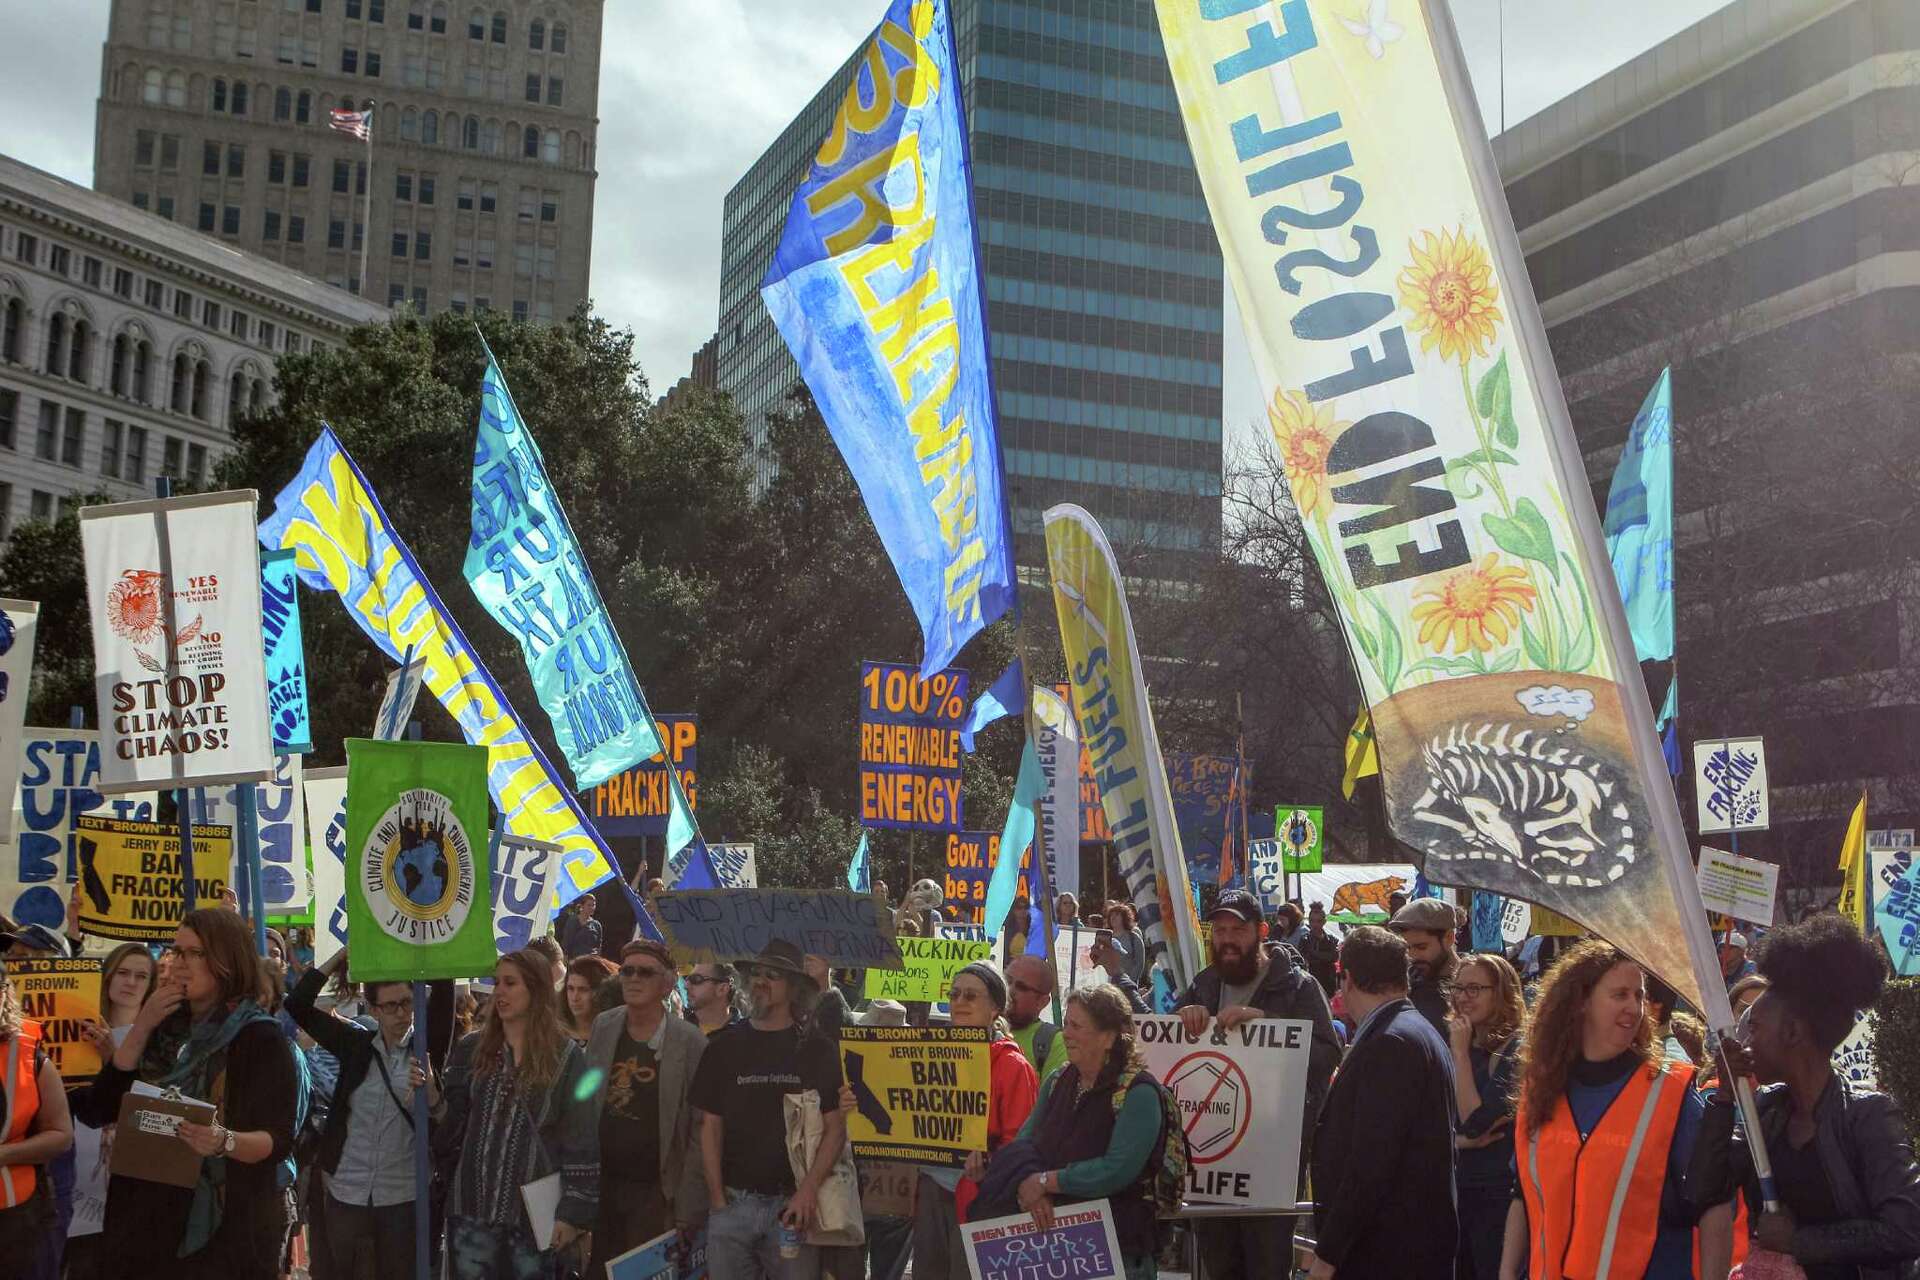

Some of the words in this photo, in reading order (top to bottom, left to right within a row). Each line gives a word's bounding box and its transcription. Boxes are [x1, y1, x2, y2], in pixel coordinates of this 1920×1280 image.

[188, 574, 218, 588] YES
[200, 632, 221, 643] NO
[112, 672, 226, 713] STOP
[863, 667, 964, 720] 100%
[114, 705, 229, 735] CLIMATE
[1077, 645, 1138, 800] FUELS
[116, 728, 230, 761] CHAOS!
[862, 723, 960, 769] RENEWABLE
[1704, 750, 1730, 785] END
[596, 769, 697, 816] FRACKIG
[1706, 748, 1758, 821] FRACKING
[861, 772, 961, 824] ENERGY
[79, 817, 105, 829] TEXT
[121, 838, 159, 850] JERRY
[367, 846, 384, 893] CLIMATE
[377, 821, 397, 845] AND
[946, 834, 983, 868] Gov.
[112, 874, 224, 899] FRACKNG
[945, 874, 968, 900] be
[973, 880, 985, 900] a
[387, 911, 454, 940] JUSTICE
[31, 960, 51, 971] TO
[55, 960, 99, 971] 69866
[25, 977, 79, 990] BROWN:
[880, 980, 908, 996] AIR
[840, 1027, 868, 1038] TEXT
[870, 1028, 927, 1039] "BROWN"
[928, 1029, 947, 1039] TO
[950, 1028, 986, 1040] 69866
[1241, 1024, 1302, 1048] VILE
[889, 1047, 924, 1059] JERRY
[929, 1047, 973, 1060] BROWN:
[911, 1061, 958, 1086] BAN
[887, 1088, 987, 1116] FRACKING
[1179, 1100, 1230, 1115] FRACKING
[912, 1115, 963, 1142] NOW!
[971, 1227, 1006, 1242] SIGN
[1007, 1221, 1037, 1236] THE
[1006, 1232, 1069, 1253] OUR
[988, 1237, 1097, 1269] WATER'S
